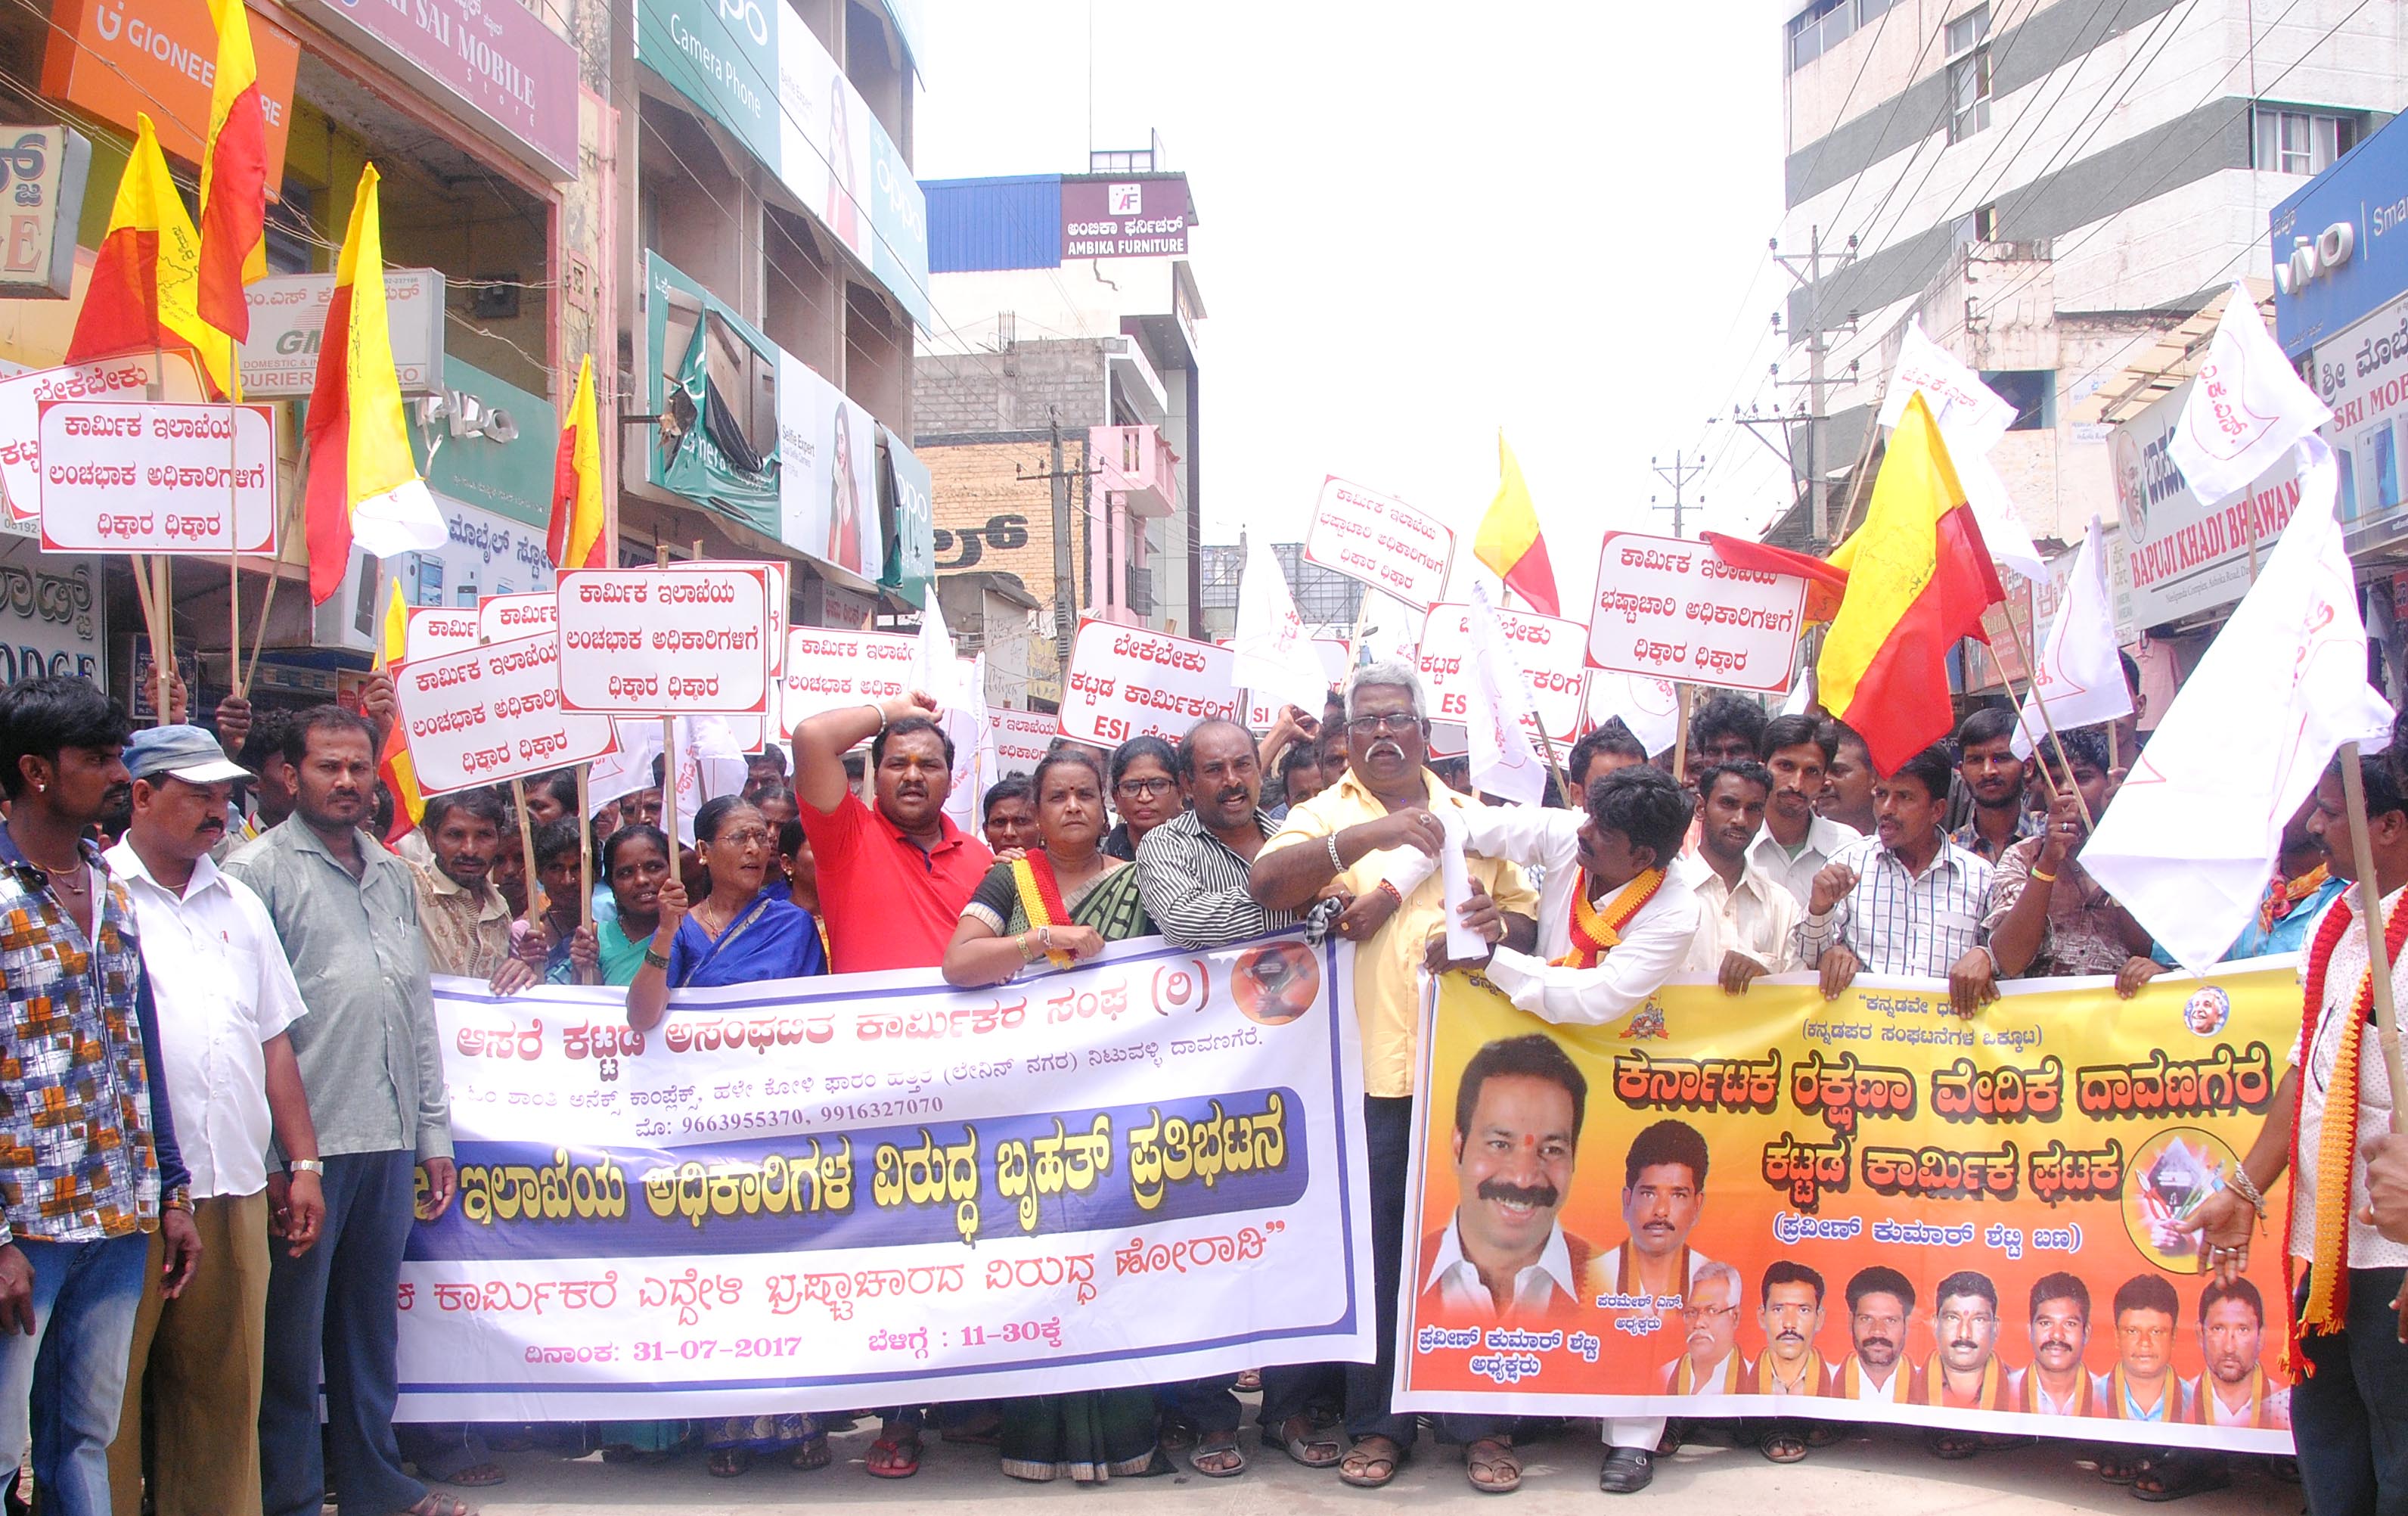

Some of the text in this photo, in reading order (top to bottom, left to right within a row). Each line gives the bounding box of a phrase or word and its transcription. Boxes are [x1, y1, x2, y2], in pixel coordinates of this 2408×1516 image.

[128, 20, 216, 89] GIONEE
[458, 25, 536, 110] MOBILE
[671, 14, 761, 119] Camera Phone
[877, 158, 921, 241] oppo
[1068, 238, 1184, 256] AMBIKA FURNITURE
[240, 371, 313, 387] OURIER
[244, 359, 300, 368] DOMESTIC
[2335, 374, 2408, 433] SRI MOB
[65, 412, 237, 440] ಕಾರ್ಮಿಕ ಇಲಾಖೆಯ
[2, 439, 39, 473] ಕಟ್ಟ
[147, 462, 265, 490] ಅಧಿಕಾರಿಗಳಿಗೆ
[2130, 534, 2177, 589] BAPUJI
[2176, 512, 2226, 570] KHADI
[2226, 477, 2300, 550] BHAWAN
[1621, 548, 1692, 573] ಕಾರ್ಮಿಕ
[579, 579, 734, 604] ಕಾರ್ಮಿಕ ಇಲಾಖೆಯ
[428, 619, 477, 637] ಕಾರ್ಮಿ
[1686, 601, 1793, 633] ಅಧಿಕಾರಿಗಳಿಗೆ
[653, 625, 758, 653] ಅಧಿಕಾರಿಗಳಿಗೆ
[802, 638, 914, 662] ಕಾರ್ಮಿಕ ಇಲಾಖೆ
[415, 657, 481, 691] ಕಾರ್ಮಿಕ
[1420, 652, 1462, 685] ಕಟ್ಟಡ
[494, 688, 560, 719] ಅಧಿಕಾರಿ
[1071, 670, 1116, 706] ಕಟ್ಟಡ
[1441, 693, 1467, 714] ES
[1094, 716, 1131, 743] ESI
[1253, 707, 1269, 722] SI
[998, 745, 1048, 762] ಅಧಿಕಾರಿಗ
[457, 1019, 544, 1060] ಆಸರೆ
[563, 1018, 646, 1081] ಕಟ್ಟಡ
[856, 995, 1028, 1042] ಕಾರ್ಮಿಕರ
[1047, 976, 1128, 1024] ಸಂಘ
[1151, 960, 1211, 1016] (ರಿ)
[1882, 1024, 1975, 1046] ಸಂಘಟನೆಗಳ
[1027, 1052, 1078, 1074] ನಗರ)
[1171, 1027, 1264, 1057] ದಾವಣಗೆರೆ.
[1614, 1042, 2273, 1133] ಕರ್ನಾಟಕ ರಕ್ಷಣಾ ವೇದಿಕೆ ದಾವಣಗೆರೆ
[682, 1108, 811, 1134] 9663955370,
[821, 1096, 944, 1123] 9916327070
[461, 1147, 626, 1225] ಇಲಾಖೆಯ
[645, 1136, 853, 1227] ಅಧಿಕಾರಿಗಳ
[875, 1124, 979, 1242] ವಿರುದ್ಧ
[997, 1114, 1112, 1231] ಬೃಹತ್
[1129, 1092, 1284, 1209] ಪ್ರತಿಭಟನೆ
[1763, 1132, 2124, 1212] ಕಟ್ಟಡ ಕಾರ್ಮಿಕ ಘಟಕ
[1773, 1212, 2082, 1260] (ಪ್ರವೀಣ್ ಕುಮಾರ್ ಶೆಟ್ಟಿ ಬಣ)
[985, 1253, 1097, 1305] ವಿರುದ್ಧ
[1597, 1294, 1651, 1310] ಪರಮೇಶ್
[1615, 1317, 1662, 1336] ಅಧ್ಯಕ್ಷರು
[526, 1341, 619, 1364] ದಿನಾಂಕ:
[634, 1337, 802, 1362] 31-07-2017
[1419, 1328, 1600, 1362] ಪ್ರವೀಣ್ ಕುಮಾರ್ ಶೆಟ್ಟಿ
[1472, 1356, 1539, 1383] ಅಧ್ಯಕ್ಷರು
